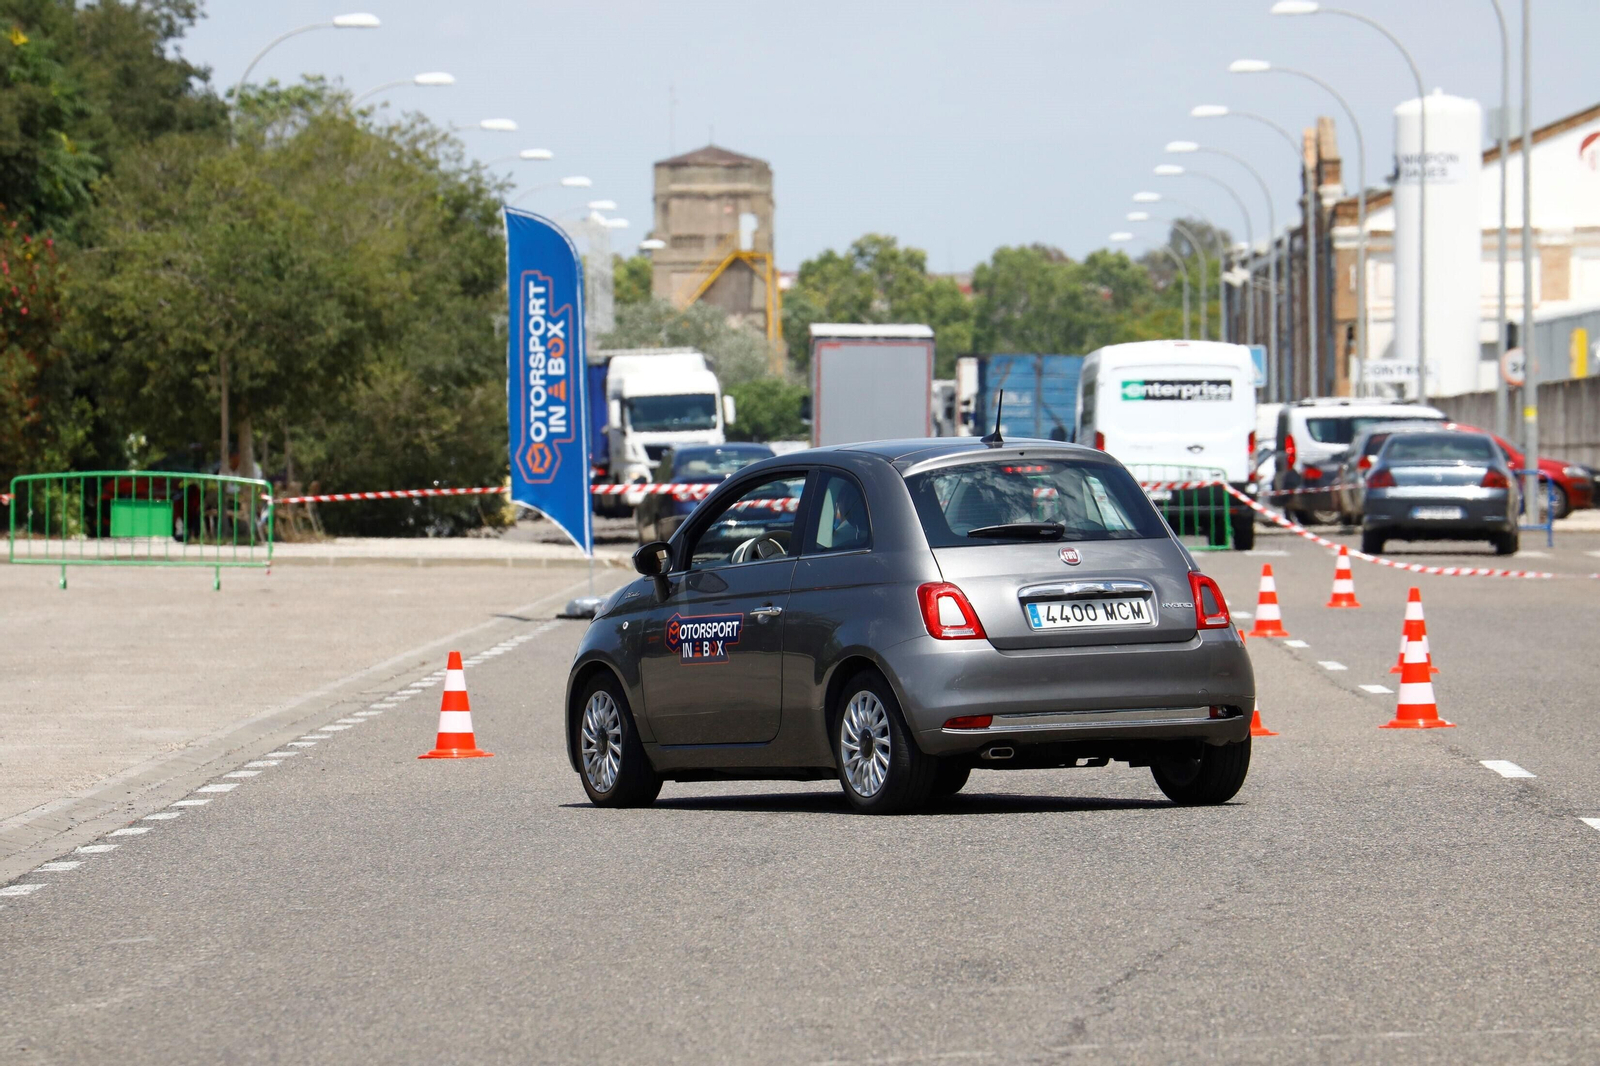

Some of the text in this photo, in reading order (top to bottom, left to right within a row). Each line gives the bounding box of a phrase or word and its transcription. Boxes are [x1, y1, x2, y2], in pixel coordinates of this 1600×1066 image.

[547, 320, 567, 375] BOX
[1122, 381, 1231, 400] enterprise
[548, 406, 567, 433] IN
[1063, 551, 1077, 560] FIAT
[1046, 601, 1145, 624] 4400 MCM
[682, 642, 693, 658] IN
[703, 640, 724, 657] BOX
